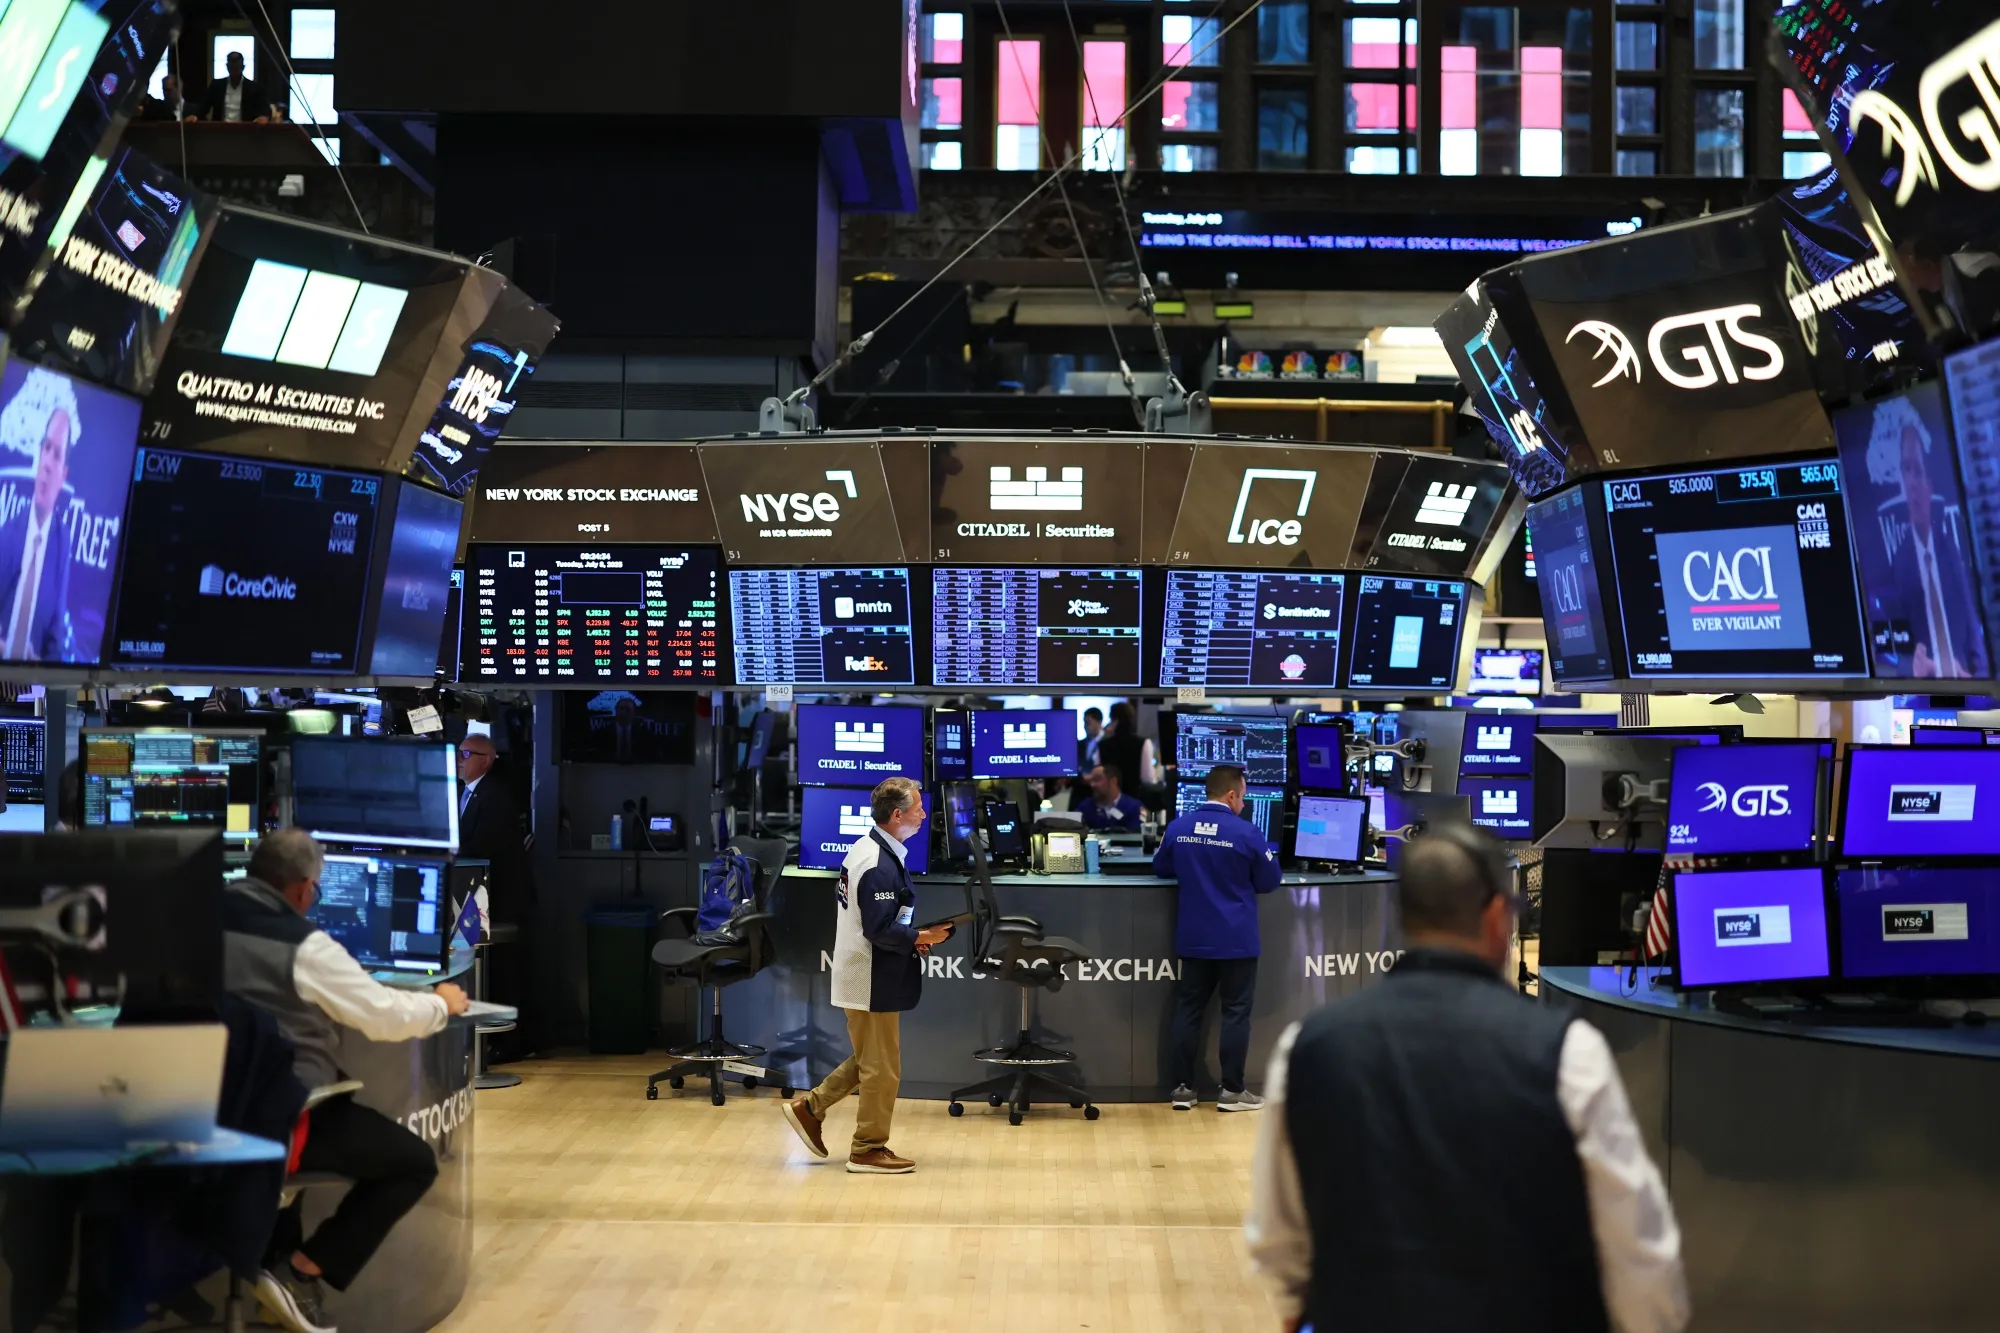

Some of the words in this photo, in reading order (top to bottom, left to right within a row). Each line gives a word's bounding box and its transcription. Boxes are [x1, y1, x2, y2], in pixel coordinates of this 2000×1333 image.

[1186, 234, 1212, 247] THE
[1213, 234, 1271, 248] OPENING
[1308, 236, 1334, 248] THE
[1336, 236, 1367, 249] NEW
[1368, 237, 1406, 250] YORK
[1407, 236, 1449, 250] STOCK
[1450, 237, 1519, 252] EXCHANGE
[93, 249, 138, 293] STOCK
[1647, 303, 1785, 390] GTS
[177, 370, 254, 400] QUATTRO
[253, 382, 274, 405] M
[273, 384, 355, 418] SECURITIES
[355, 396, 386, 421] INC.
[145, 454, 182, 475] CXW
[219, 461, 263, 482] 22.5300
[293, 472, 323, 489] 22.30
[350, 478, 378, 495] 22.58
[1612, 483, 1641, 502] CACI
[1669, 476, 1714, 494] 505.0000
[1739, 470, 1775, 489] 375.50
[1800, 465, 1838, 483] 565.00
[485, 488, 519, 501] NEW
[522, 489, 563, 501] YORK
[567, 489, 616, 502] STOCK
[620, 489, 698, 502] EXCHANGE
[1796, 503, 1827, 519] CACI
[333, 511, 359, 526] CXW
[578, 523, 601, 533] POST
[603, 523, 610, 533] 5
[956, 522, 1031, 537] CITADEL
[1045, 523, 1115, 538] Securities
[1797, 521, 1829, 532] LISTED
[327, 539, 355, 554] NYSE
[1387, 532, 1426, 549] CITADEL
[1430, 536, 1467, 552] Securities
[1799, 533, 1832, 549] NYSE
[646, 570, 664, 578] VOLU
[1682, 546, 1779, 603] CACI
[224, 572, 297, 600] CoreCivic
[1364, 578, 1384, 590] SCHW
[1553, 564, 1583, 614] CACI
[479, 608, 494, 616] UTIL
[511, 608, 526, 617] 0.00
[855, 600, 893, 613] mntn
[1277, 606, 1332, 618] SentinelOne
[480, 618, 493, 626] DXY
[508, 618, 526, 626] 97.34
[620, 619, 638, 627] -49.37
[1692, 617, 1724, 632] EVER
[1724, 615, 1782, 631] VIGILANT
[675, 630, 692, 638] 17.04
[700, 630, 716, 638] -0.75
[623, 639, 639, 647] -0.76
[667, 640, 692, 648] 2,214.23
[697, 640, 716, 648] -34.81
[557, 668, 575, 676] FANG
[672, 669, 692, 677] 257.98
[769, 686, 790, 696] 1640
[1180, 688, 1202, 697] 2296
[818, 758, 857, 770] CITADEL
[864, 761, 902, 772] Securities
[989, 754, 1023, 764] CITADEL
[1028, 754, 1061, 764] Securities
[1463, 754, 1491, 763] CITADEL
[1495, 754, 1521, 763] Securities
[1731, 784, 1790, 817] GTS
[1503, 818, 1530, 827] Securities
[1176, 835, 1203, 844] CITADEL
[1206, 837, 1234, 848] Securities
[874, 891, 895, 901] 3333
[1304, 952, 1360, 978] NEW
[1364, 949, 1407, 974] YO
